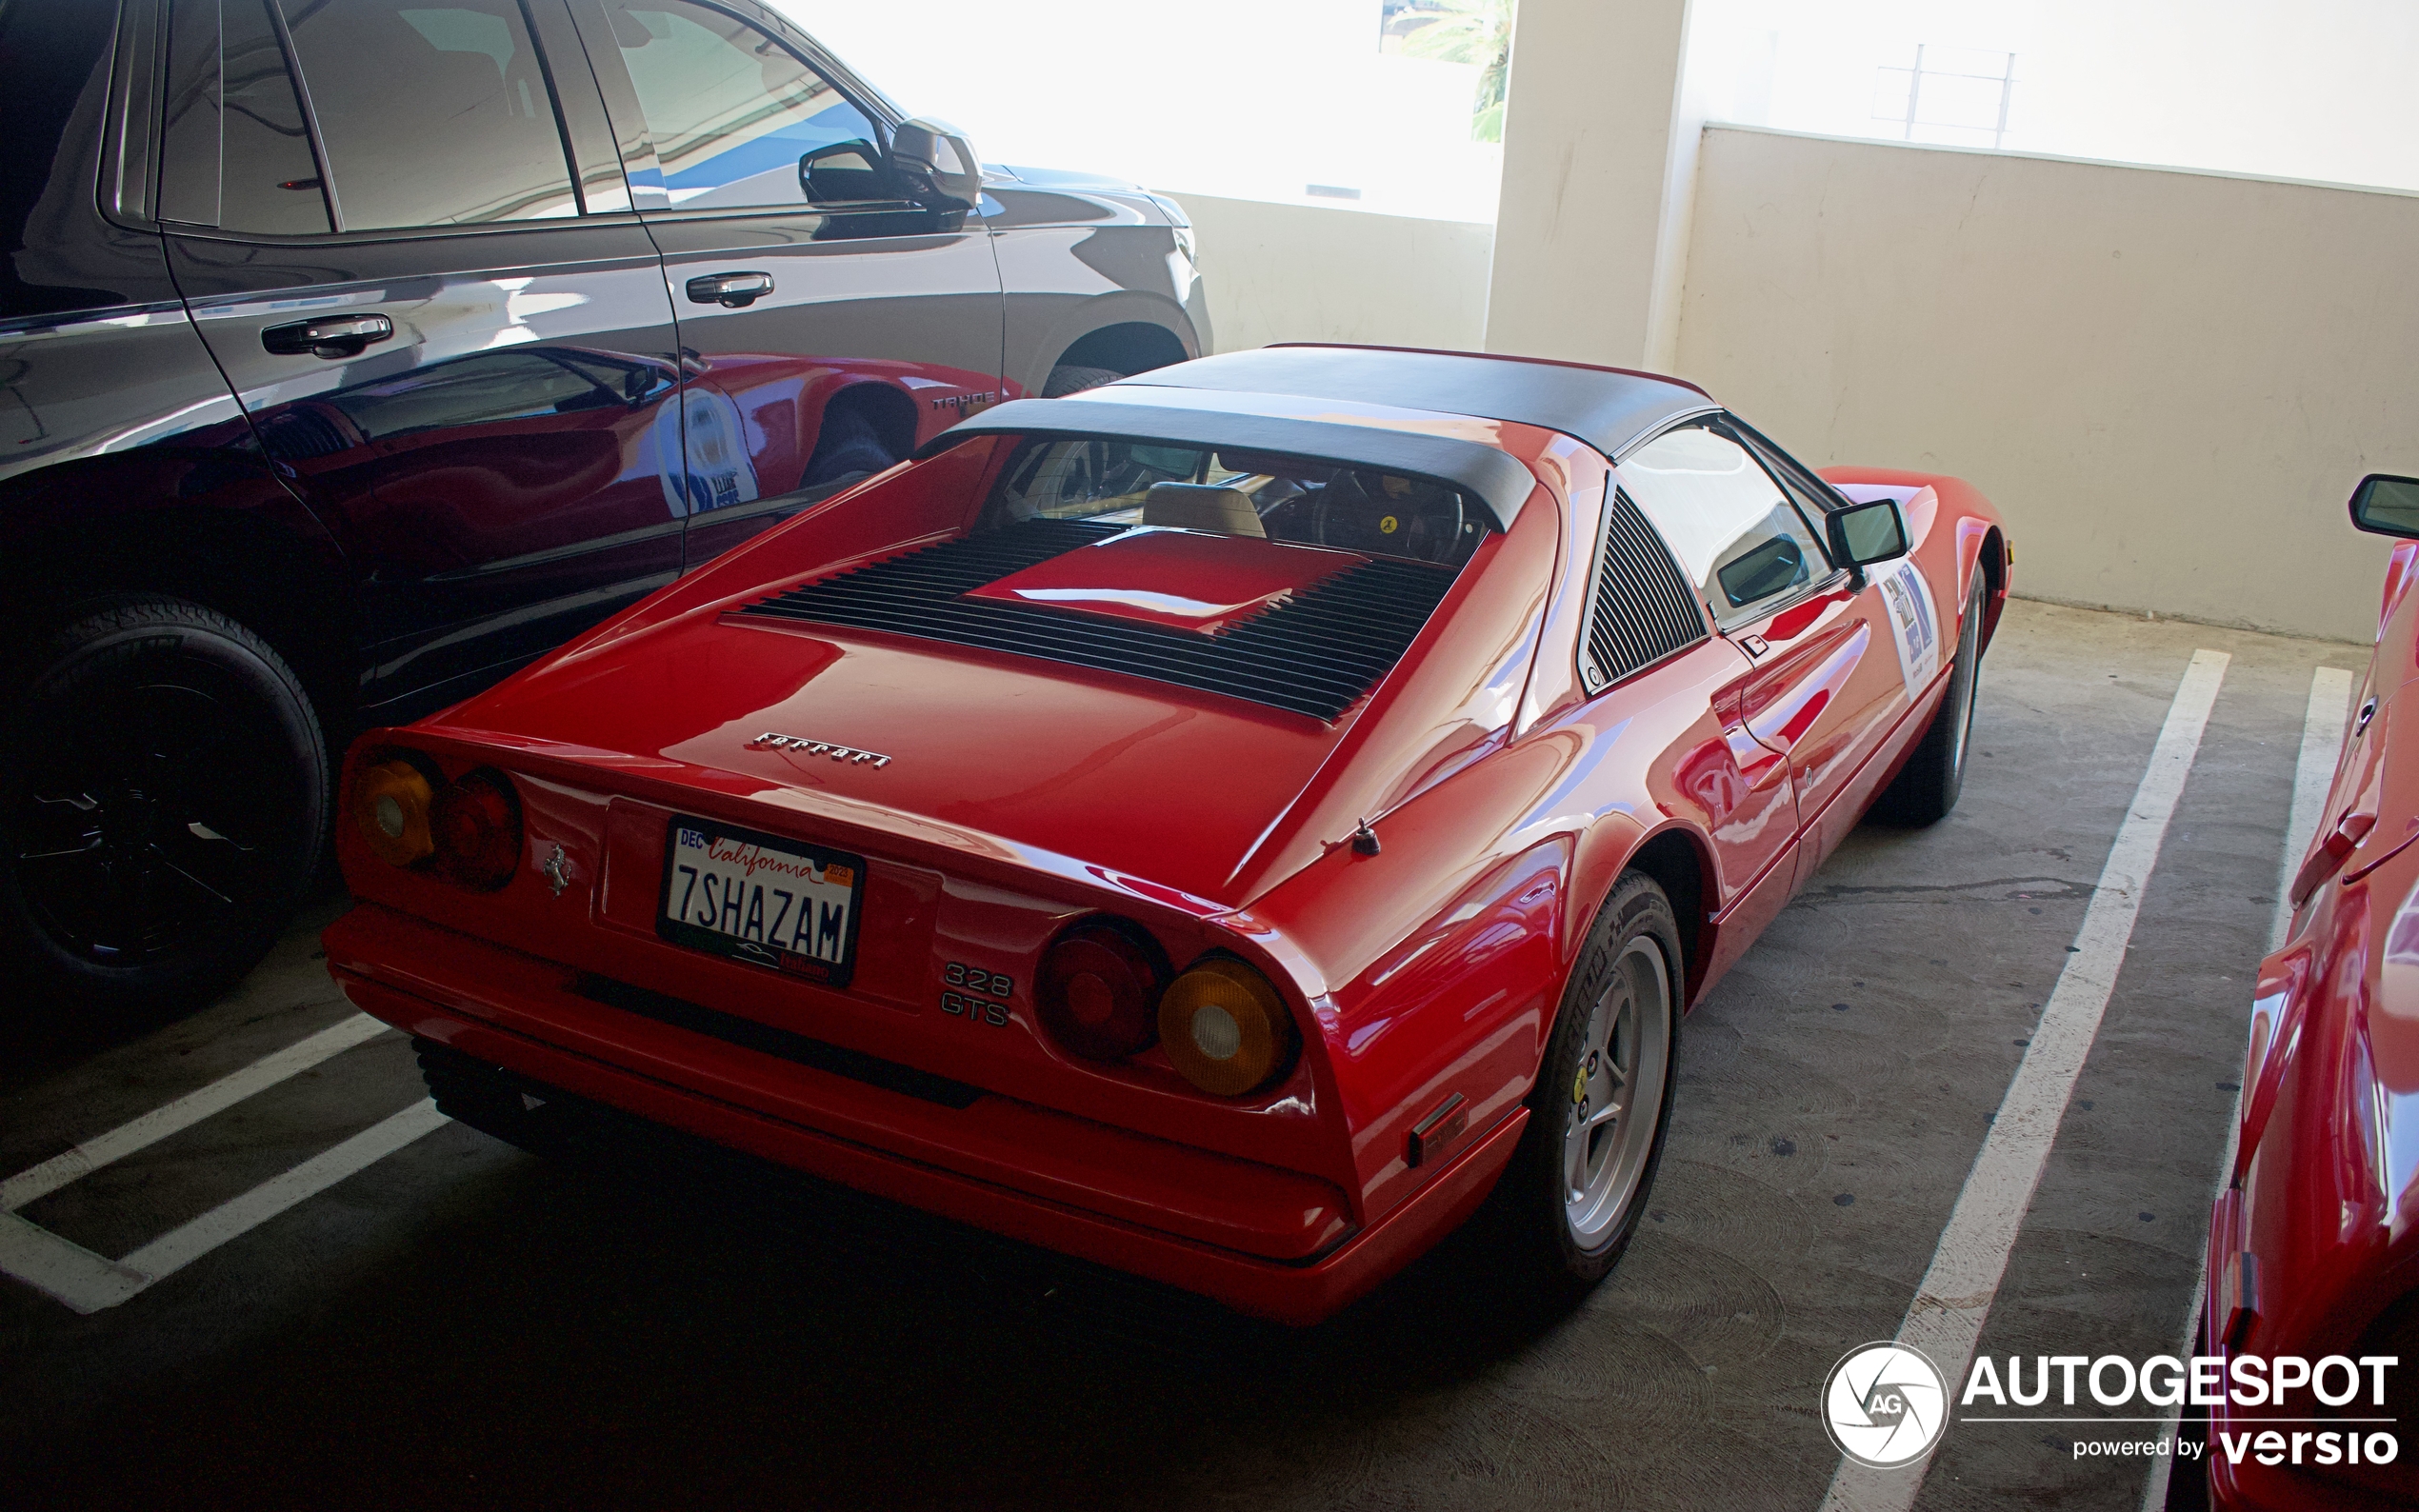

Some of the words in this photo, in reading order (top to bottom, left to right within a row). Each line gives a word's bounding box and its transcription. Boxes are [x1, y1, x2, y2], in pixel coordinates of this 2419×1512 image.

[931, 391, 995, 409] TAHOE
[752, 732, 892, 769] Ferrari
[681, 829, 704, 849] DEC
[709, 836, 825, 885] California
[678, 864, 844, 962] 7SHAZAM
[945, 962, 1013, 998] 328
[941, 992, 1008, 1026] GTS
